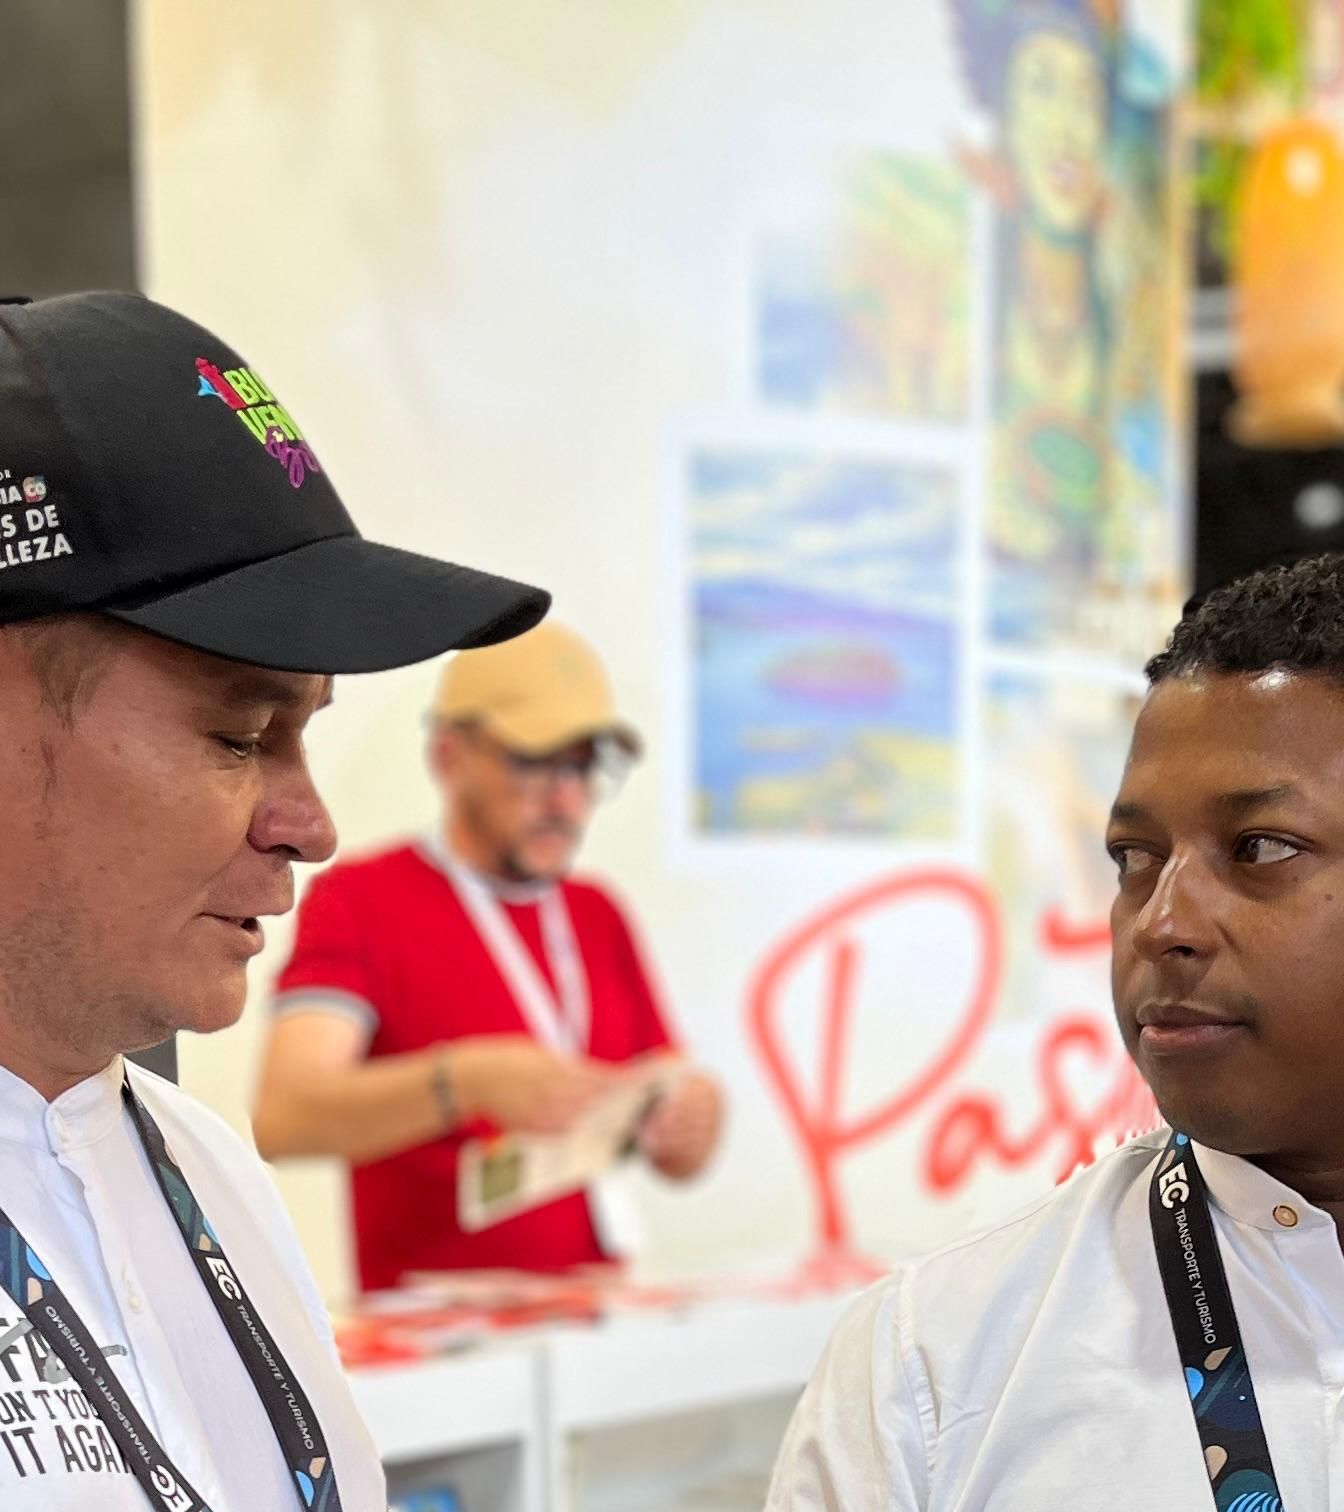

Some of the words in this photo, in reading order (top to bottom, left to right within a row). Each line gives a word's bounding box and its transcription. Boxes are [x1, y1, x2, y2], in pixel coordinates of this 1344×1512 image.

[25, 504, 60, 532] DE
[1174, 1207, 1201, 1282] TRANSPORTE
[1192, 1281, 1203, 1291] Y
[45, 1305, 90, 1366] TURISMO
[1193, 1290, 1217, 1344] TURISMO
[87, 1365, 97, 1377] Y
[237, 1304, 284, 1381] TRANSPORTE
[280, 1382, 289, 1391] Y
[285, 1392, 315, 1450] TURISMO
[95, 1376, 151, 1465] TRANSPORTE
[0, 1427, 46, 1477] IT
[55, 1424, 133, 1474] AGA
